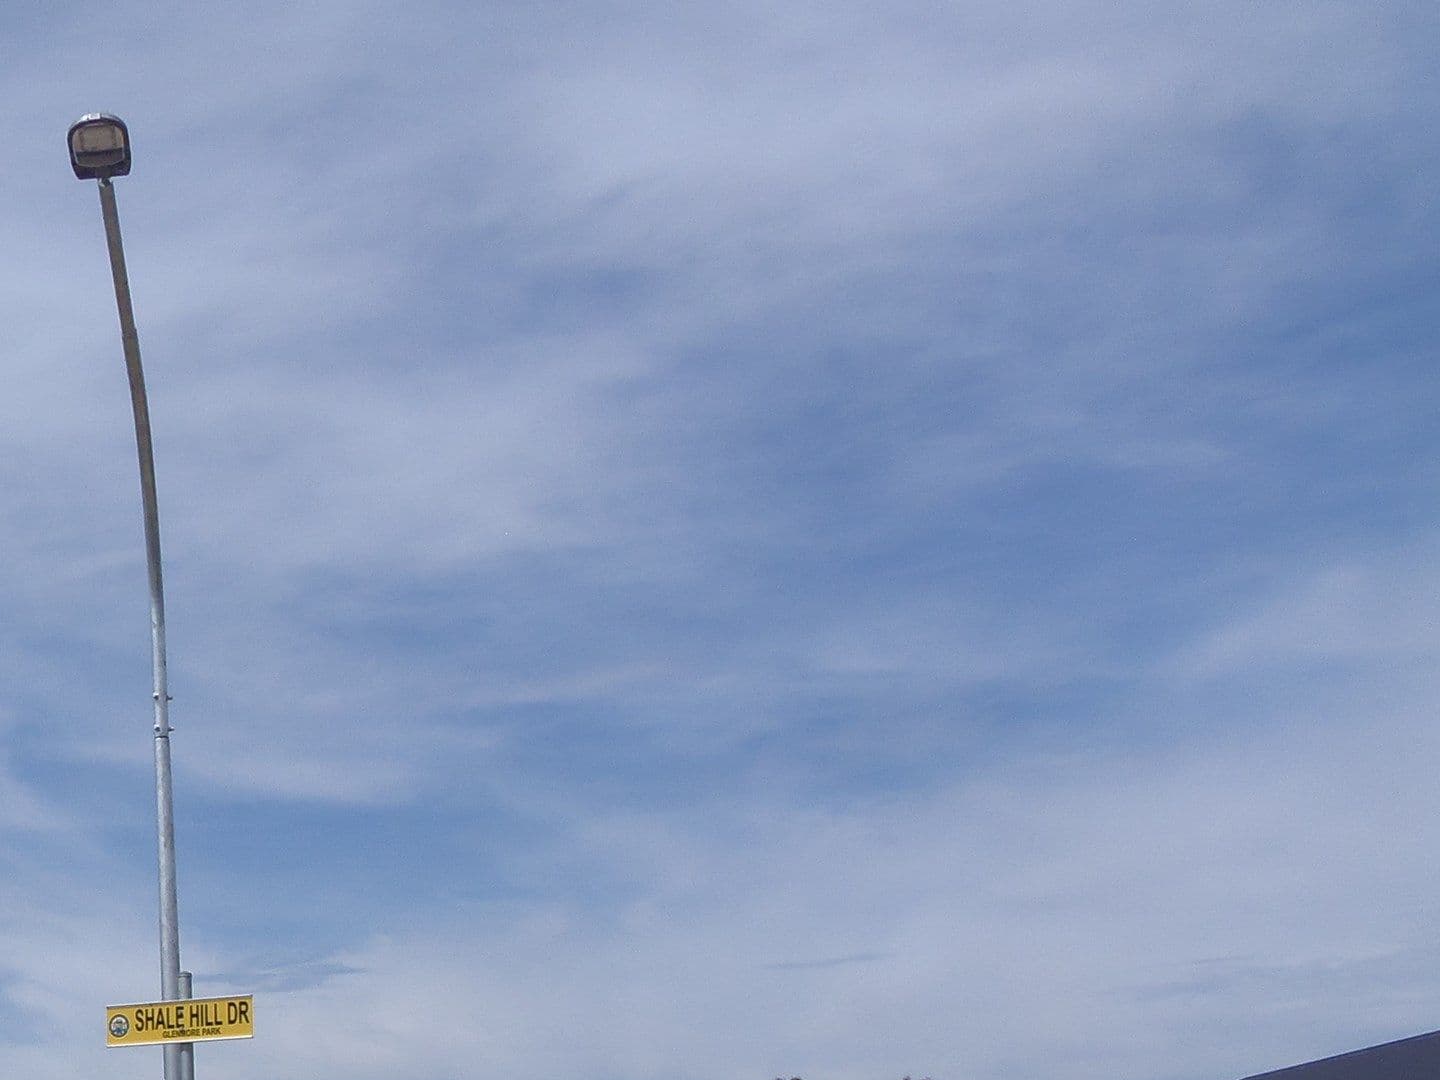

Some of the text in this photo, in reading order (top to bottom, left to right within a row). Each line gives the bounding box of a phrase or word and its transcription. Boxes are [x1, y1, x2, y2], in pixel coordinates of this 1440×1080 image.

[134, 1001, 250, 1032] SHALE HILL DR
[201, 1026, 222, 1037] PARK
